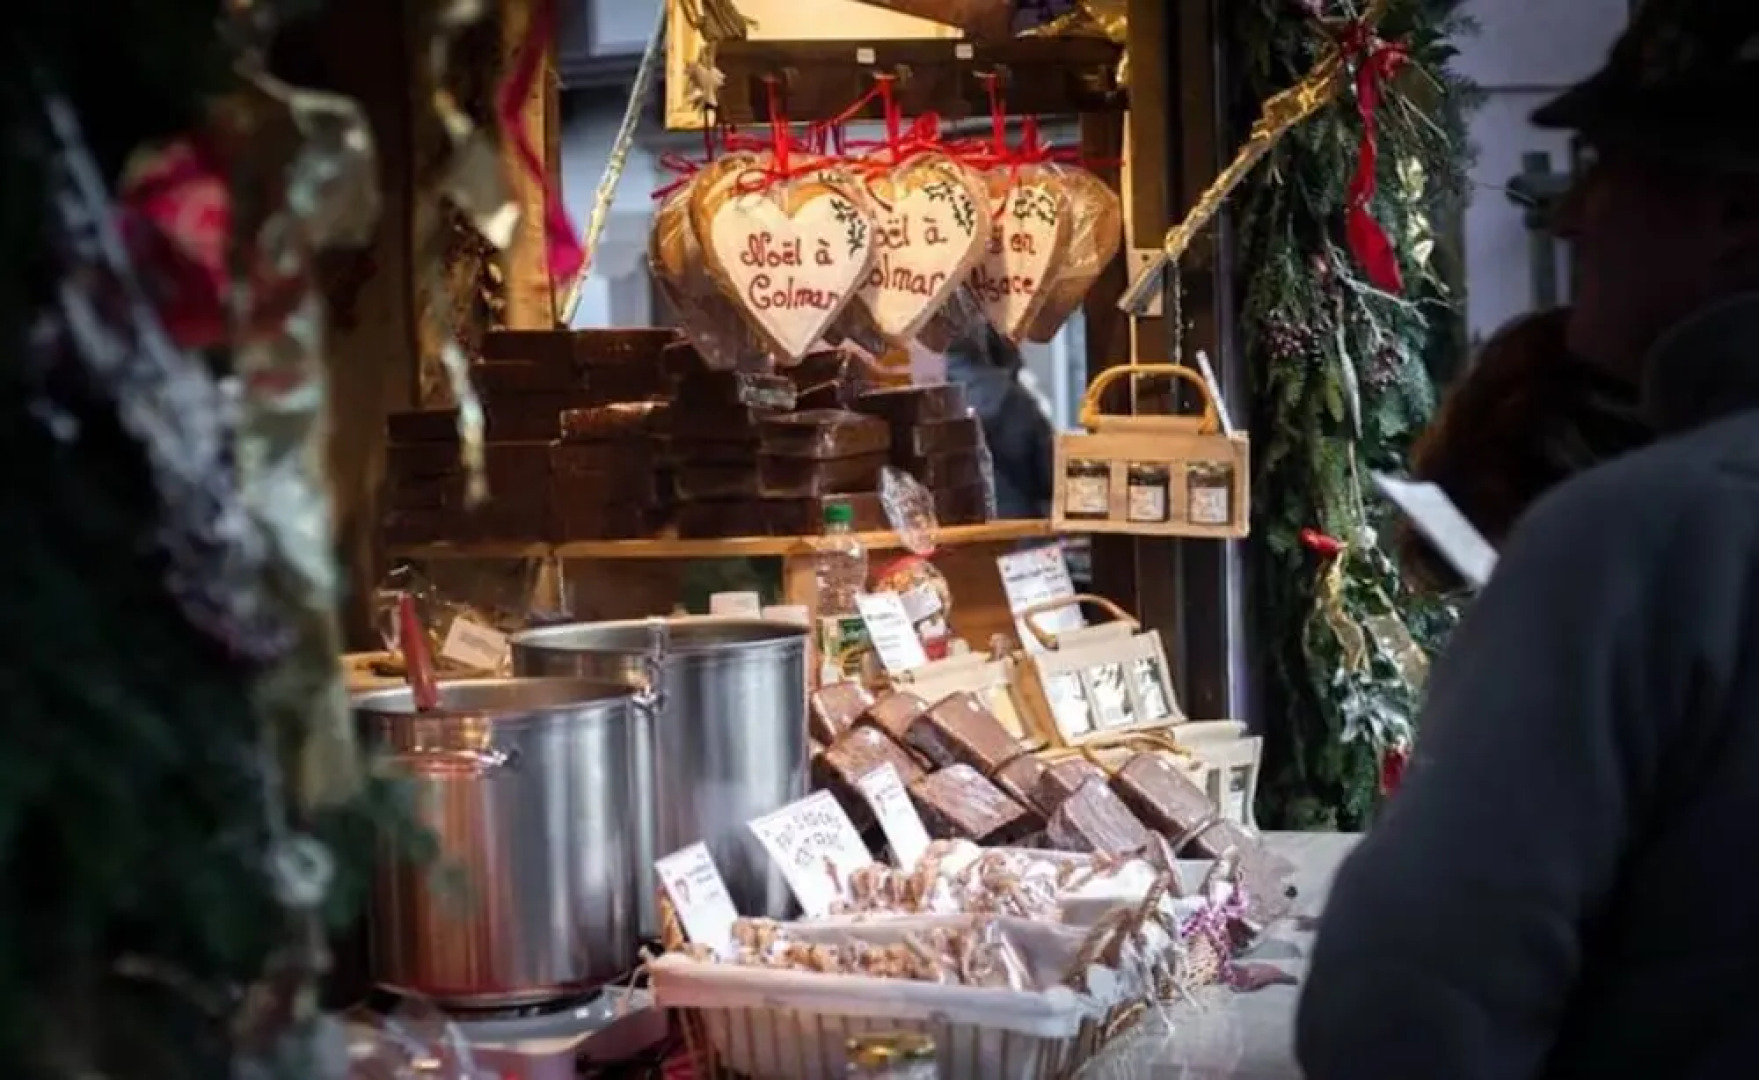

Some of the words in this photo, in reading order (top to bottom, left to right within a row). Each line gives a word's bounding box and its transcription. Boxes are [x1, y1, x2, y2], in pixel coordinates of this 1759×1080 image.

[740, 231, 802, 267] Noël
[815, 238, 834, 266] à
[870, 213, 910, 249] oël
[922, 216, 948, 245] à
[1010, 232, 1036, 255] en
[748, 273, 840, 310] Colmar
[856, 252, 945, 296] olmar
